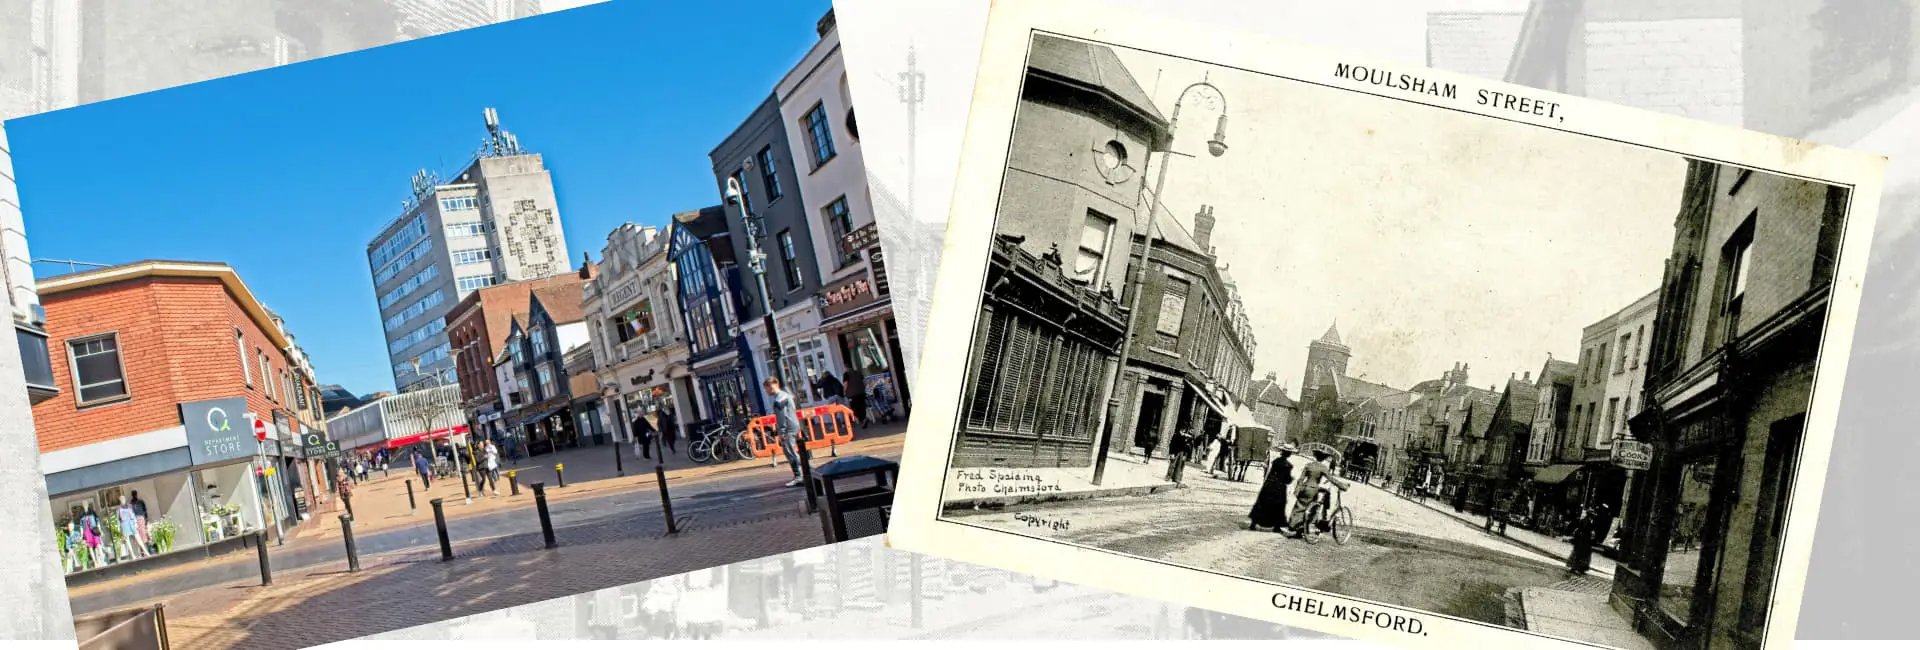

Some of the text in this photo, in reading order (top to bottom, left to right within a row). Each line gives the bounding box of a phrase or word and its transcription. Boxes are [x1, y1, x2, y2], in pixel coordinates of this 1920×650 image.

[206, 441, 241, 456] STORE
[956, 469, 984, 480] Fred
[958, 482, 986, 493] Photo
[1014, 512, 1070, 530] Copyright
